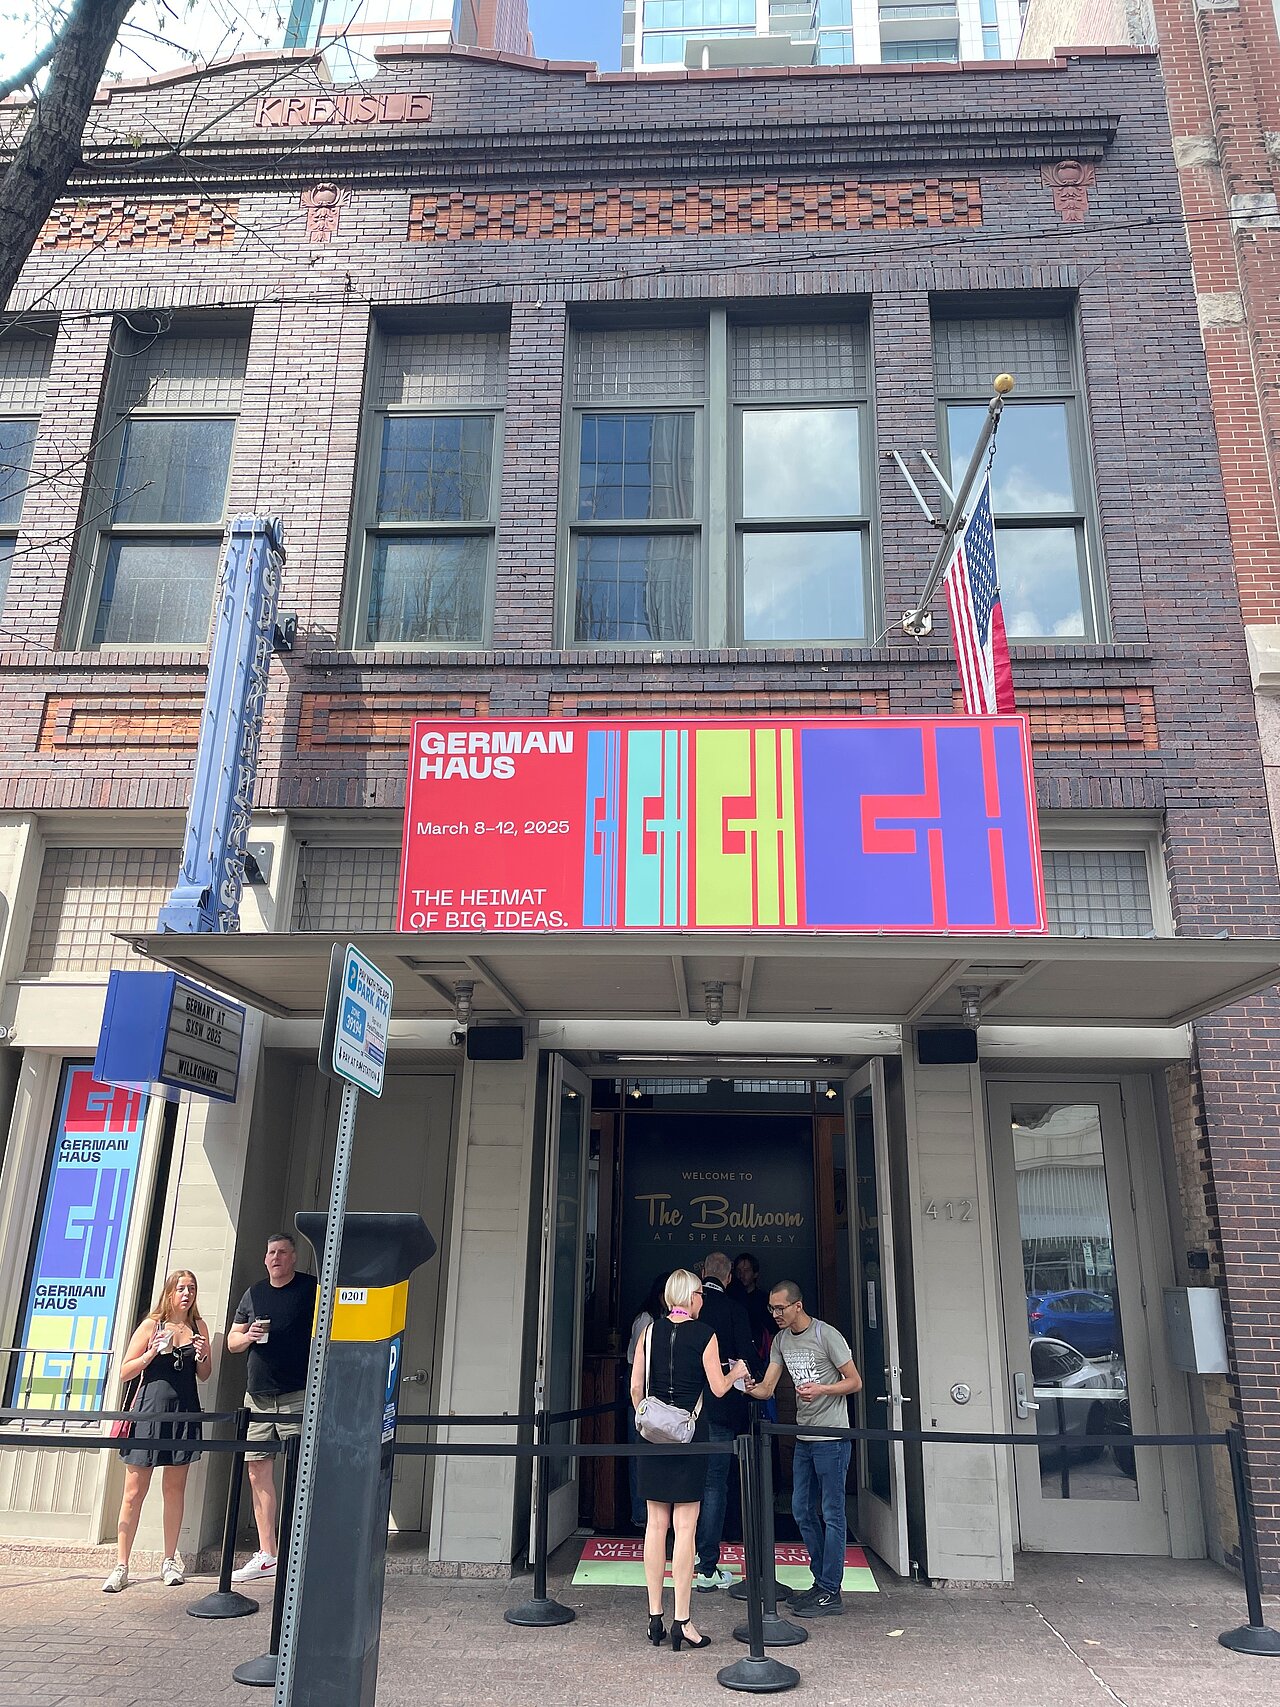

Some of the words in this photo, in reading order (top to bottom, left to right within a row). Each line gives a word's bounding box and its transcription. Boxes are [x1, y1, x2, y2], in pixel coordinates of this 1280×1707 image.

[255, 94, 431, 127] KREISLE
[420, 731, 574, 754] GERMAN
[419, 756, 515, 780] HAUS
[417, 821, 469, 835] March
[524, 821, 570, 834] 2025
[411, 889, 454, 906] THE
[460, 888, 547, 906] HEIMAT
[410, 911, 438, 928] OF
[446, 911, 486, 928] BIG
[494, 911, 569, 928] IDEAS.
[357, 982, 375, 1007] PARK
[375, 996, 389, 1017] ATX
[185, 997, 214, 1020] GERMANY
[217, 1011, 226, 1026] AT
[186, 1018, 204, 1037] SXSW
[207, 1028, 222, 1044] 2025
[178, 1058, 219, 1085] WILLKOMMEN
[60, 1139, 129, 1151] GERMAN
[58, 1151, 102, 1163] HAUS
[682, 1172, 735, 1181] WELCOME
[739, 1172, 753, 1181] TO
[634, 1193, 683, 1227] The
[689, 1195, 804, 1229] Ballroom
[926, 1199, 974, 1221] 412
[654, 1232, 673, 1241] AT
[688, 1233, 796, 1243] SPEAKEASY
[36, 1284, 106, 1298] GERMAN
[341, 1291, 364, 1301] 0201
[33, 1297, 77, 1310] HAUS
